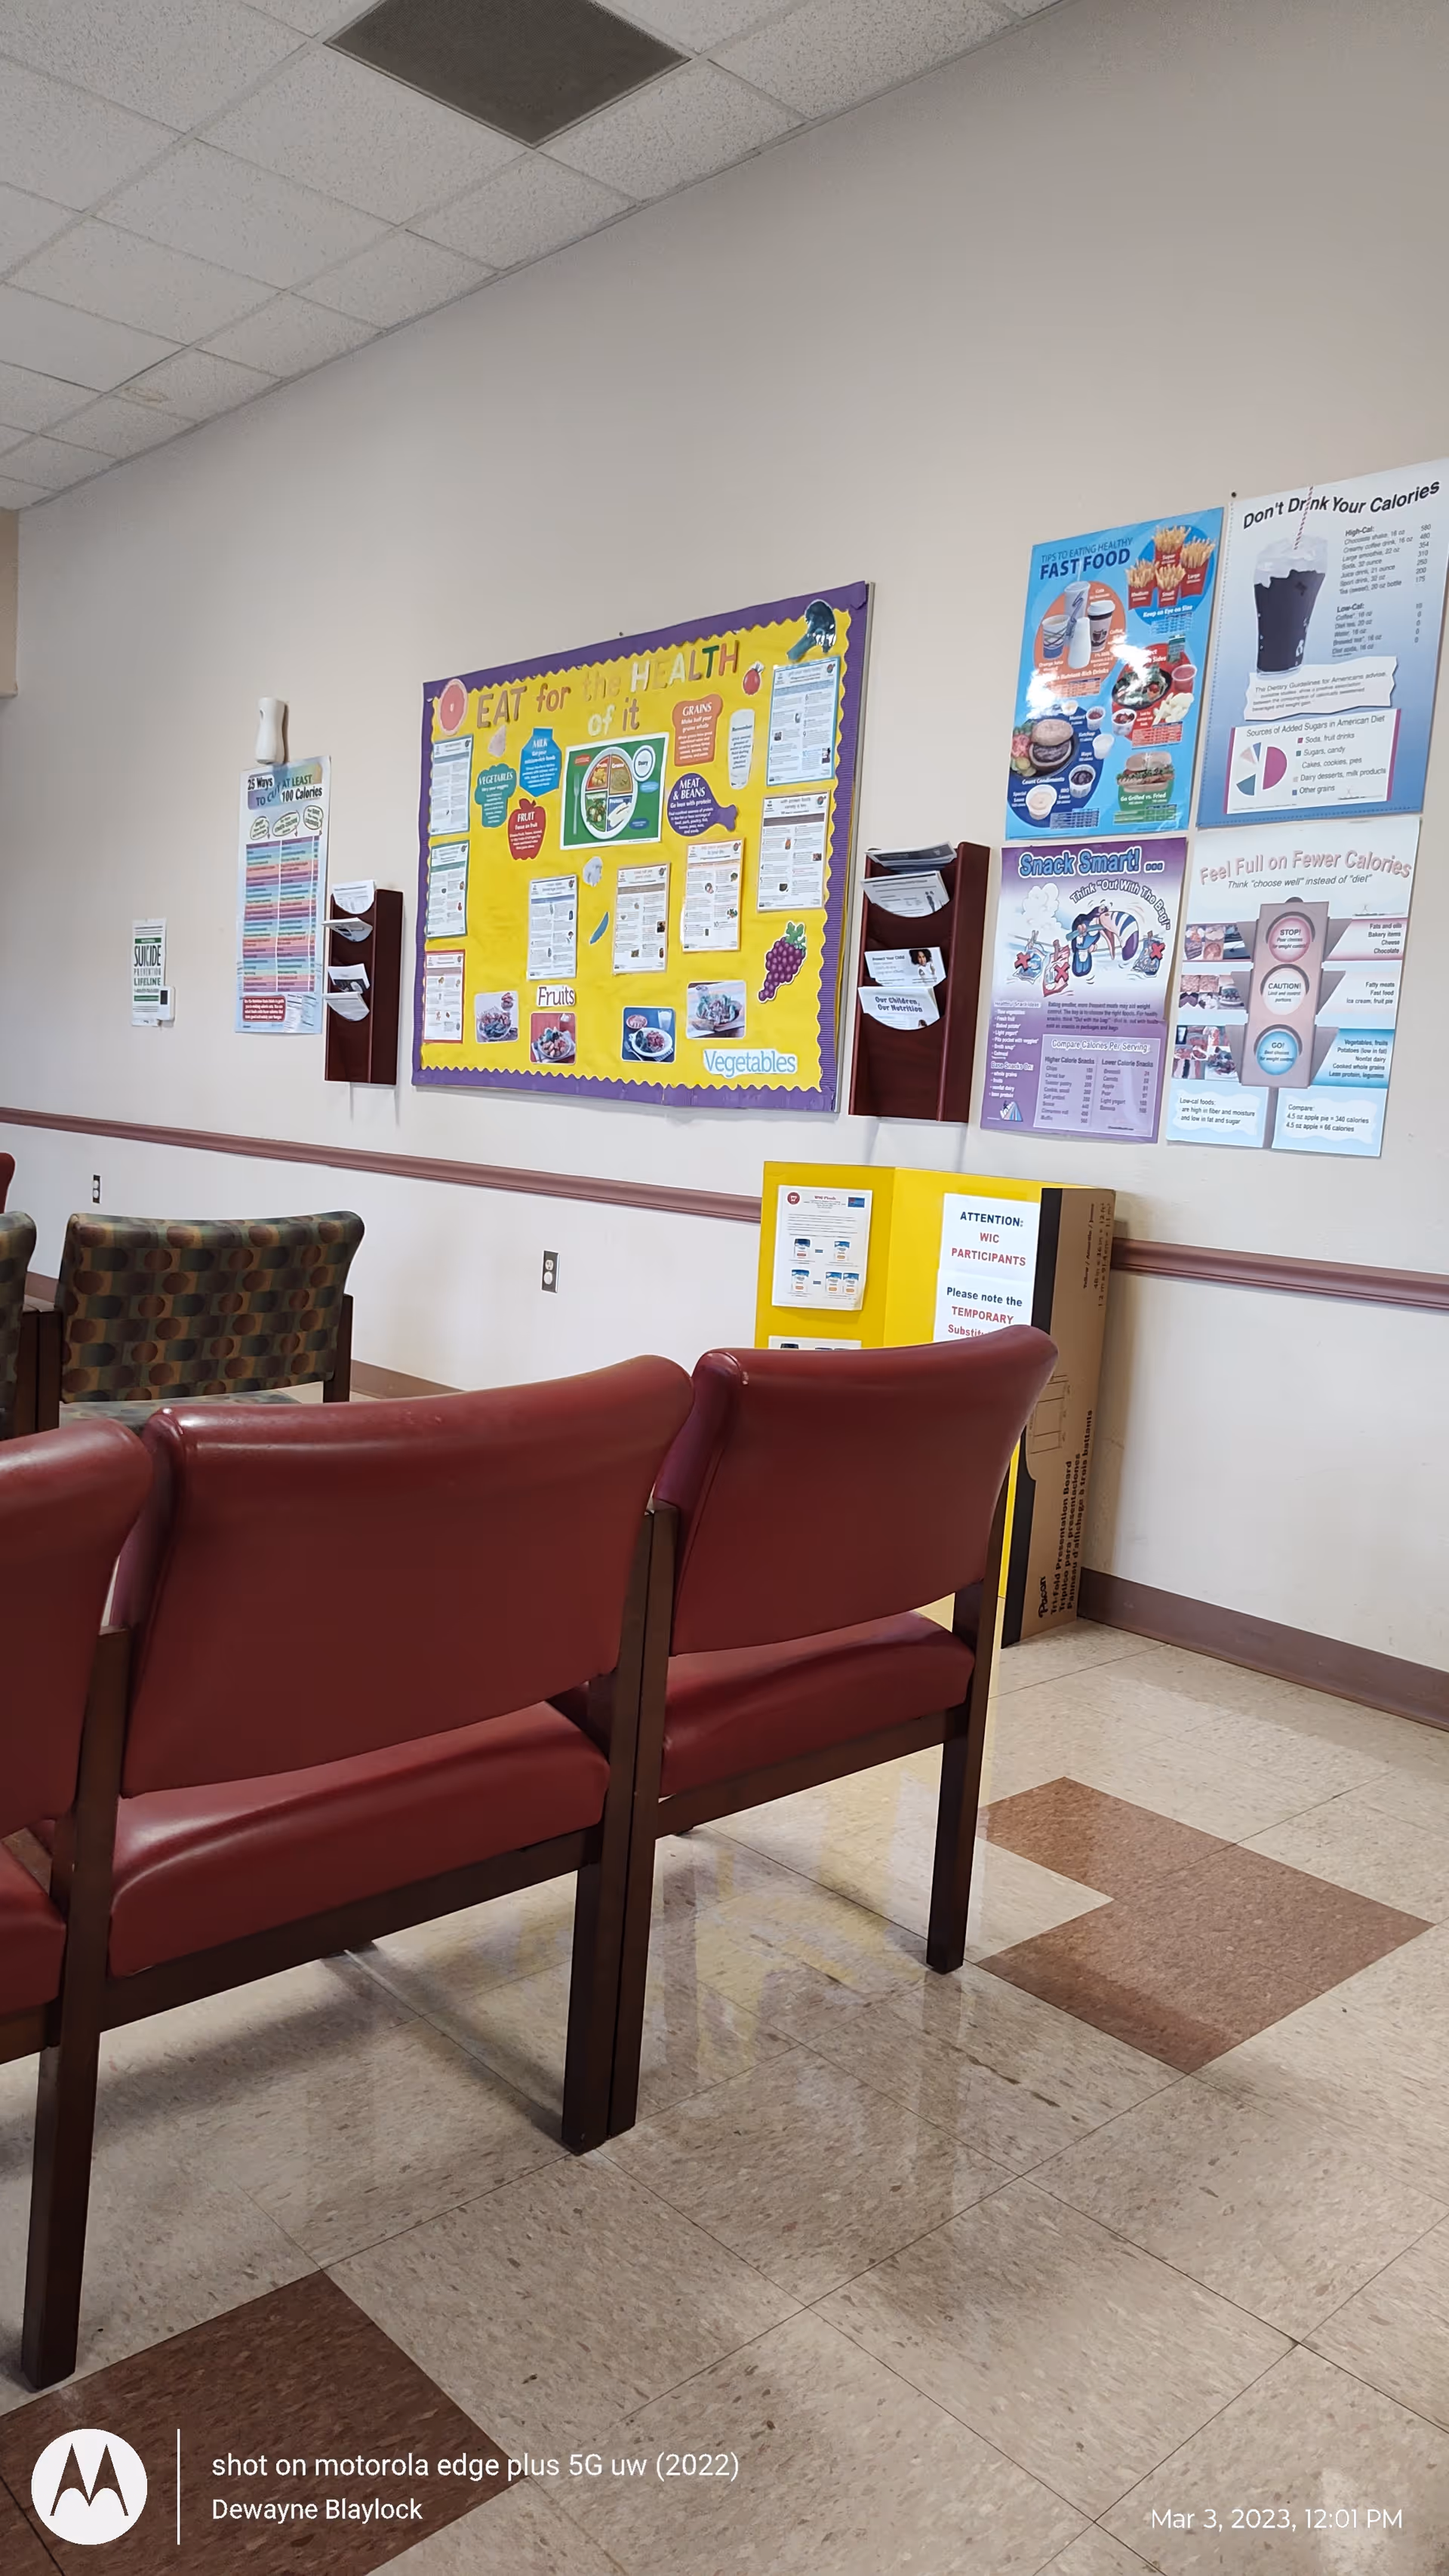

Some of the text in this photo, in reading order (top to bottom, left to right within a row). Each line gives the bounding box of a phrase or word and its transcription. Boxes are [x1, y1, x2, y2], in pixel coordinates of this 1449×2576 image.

[1244, 481, 1440, 529] Don't Drnk Your Calories
[1041, 537, 1134, 562] TIPS TO EATING HEALTHY
[1040, 549, 1131, 580] FAST FOOD
[476, 640, 740, 728] EAT for the HEALTH
[588, 697, 641, 737] of it
[682, 702, 712, 717] GRAINS
[1282, 725, 1303, 733] Added
[1305, 721, 1328, 731] Sugars
[1337, 716, 1369, 728] American
[532, 738, 548, 749] MILK
[1324, 734, 1336, 743] fruit
[1337, 732, 1355, 740] drinks
[1303, 746, 1346, 756] Sugars, candy
[1302, 761, 1322, 769] Cakes,
[1349, 757, 1362, 765] pies
[478, 771, 513, 786] VEGETABLES
[679, 777, 700, 789] MEAT
[1300, 768, 1386, 783] Dairy desserts, milk products
[248, 777, 273, 791] 25 Ways
[256, 774, 312, 806] TO CUT AT LEAST
[1317, 785, 1335, 794] grains
[281, 786, 323, 802] 100 Calories
[673, 787, 706, 801] & BEANS
[517, 811, 535, 823] FRUIT
[1020, 852, 1075, 876] Snack
[1079, 848, 1140, 873] Smart!
[1200, 850, 1413, 885] Feel Full on Fewer Calories
[1228, 881, 1248, 889] Think
[1306, 876, 1337, 885] instead
[1338, 876, 1349, 884] of
[1070, 882, 1097, 904] Think
[1120, 880, 1140, 894] With
[1140, 886, 1157, 905] The
[134, 945, 162, 967] SUICIDE
[134, 977, 161, 986] LIFELINE
[538, 986, 575, 1005] Fruits
[1052, 1040, 1080, 1048] Compare
[705, 1050, 796, 1078] Vegetables
[1045, 1056, 1060, 1064] Higher
[960, 1211, 1024, 1228] ATTENTION:
[979, 1233, 1001, 1245] WIC
[951, 1248, 1027, 1267] PARTICIPANTS
[946, 1287, 1023, 1307] Please note the
[952, 1306, 1014, 1325] TEMPORARY
[948, 1325, 984, 1337] Substit
[1056, 1499, 1069, 1571] Presentation
[1063, 1461, 1072, 1495] Board
[1038, 1576, 1048, 1618] Pacon
